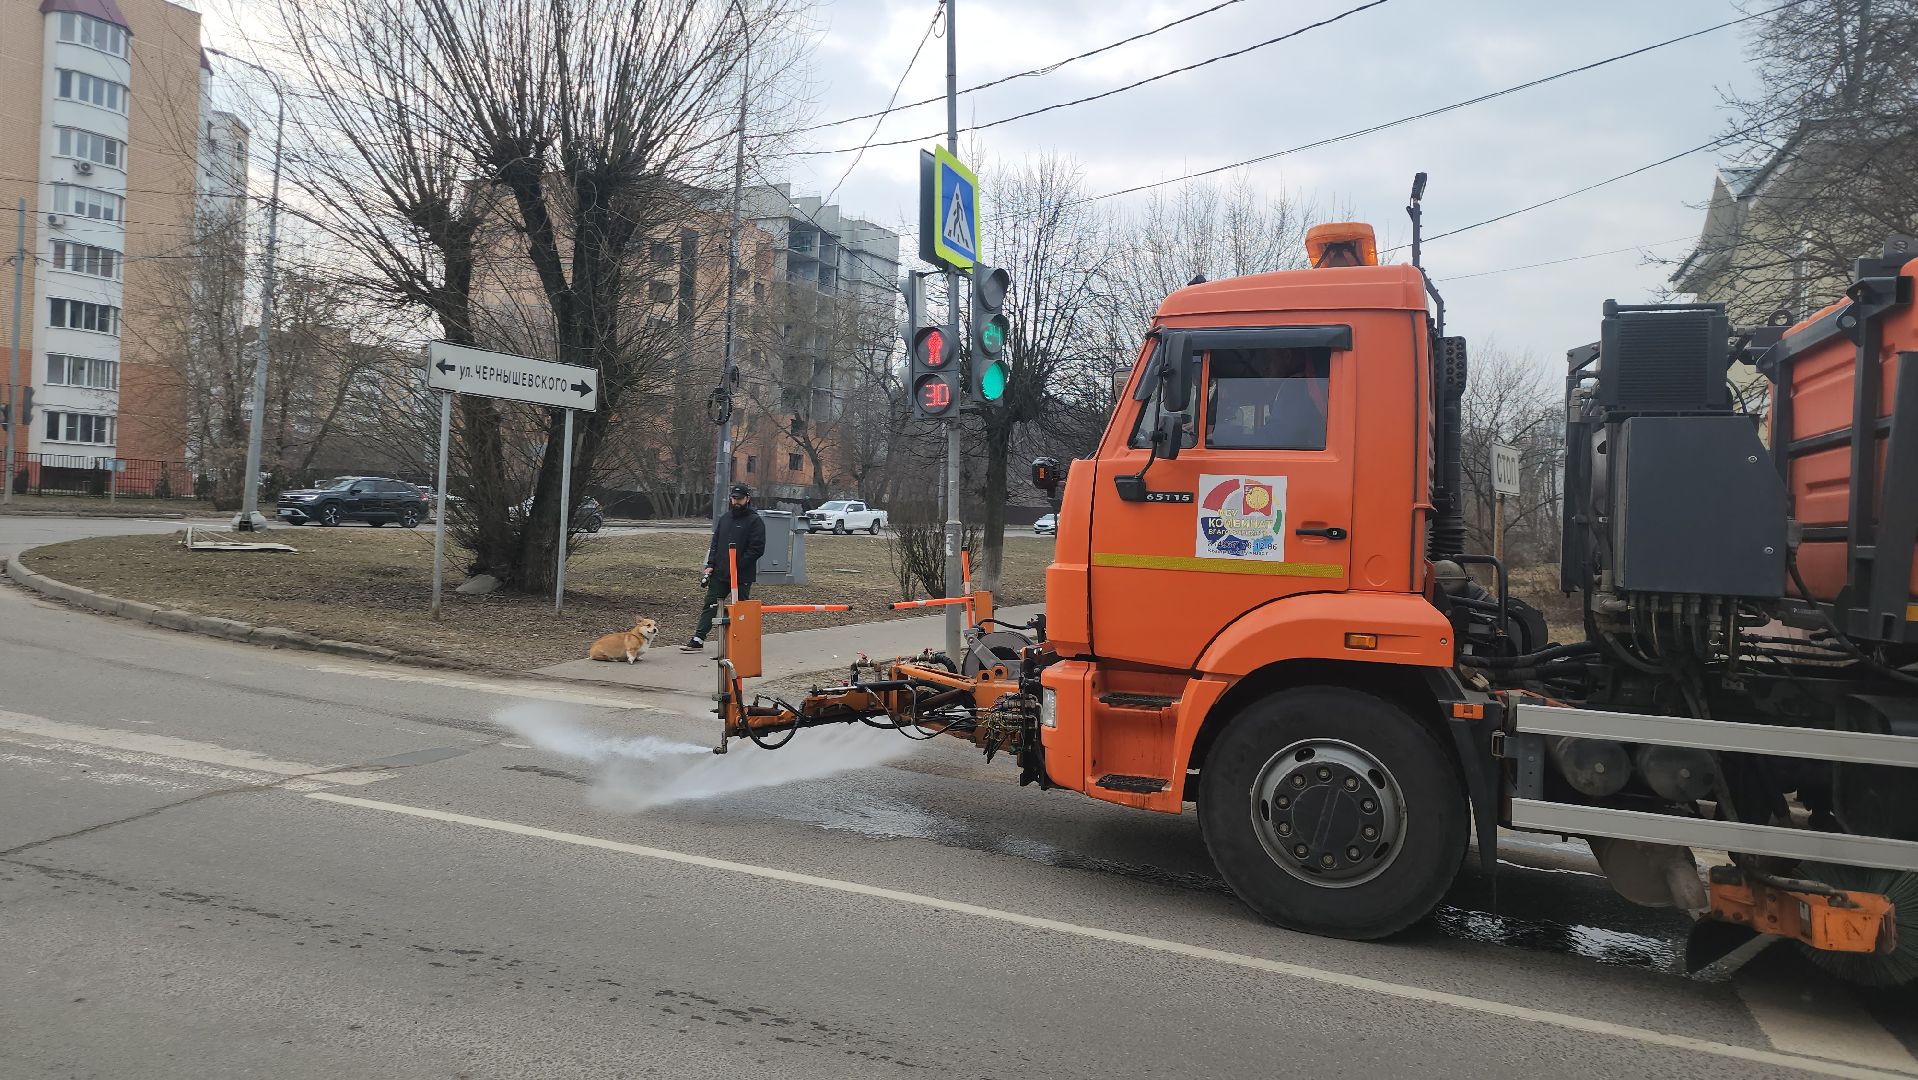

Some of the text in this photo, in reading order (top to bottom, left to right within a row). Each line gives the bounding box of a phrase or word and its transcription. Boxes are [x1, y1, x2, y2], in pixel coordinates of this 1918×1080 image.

[983, 323, 1001, 345] 24
[459, 365, 567, 392] ул. ЧЕРНЫШЕВСКОГО
[925, 384, 950, 406] 30
[1497, 453, 1517, 484] СТОП
[1146, 493, 1190, 501] 65115
